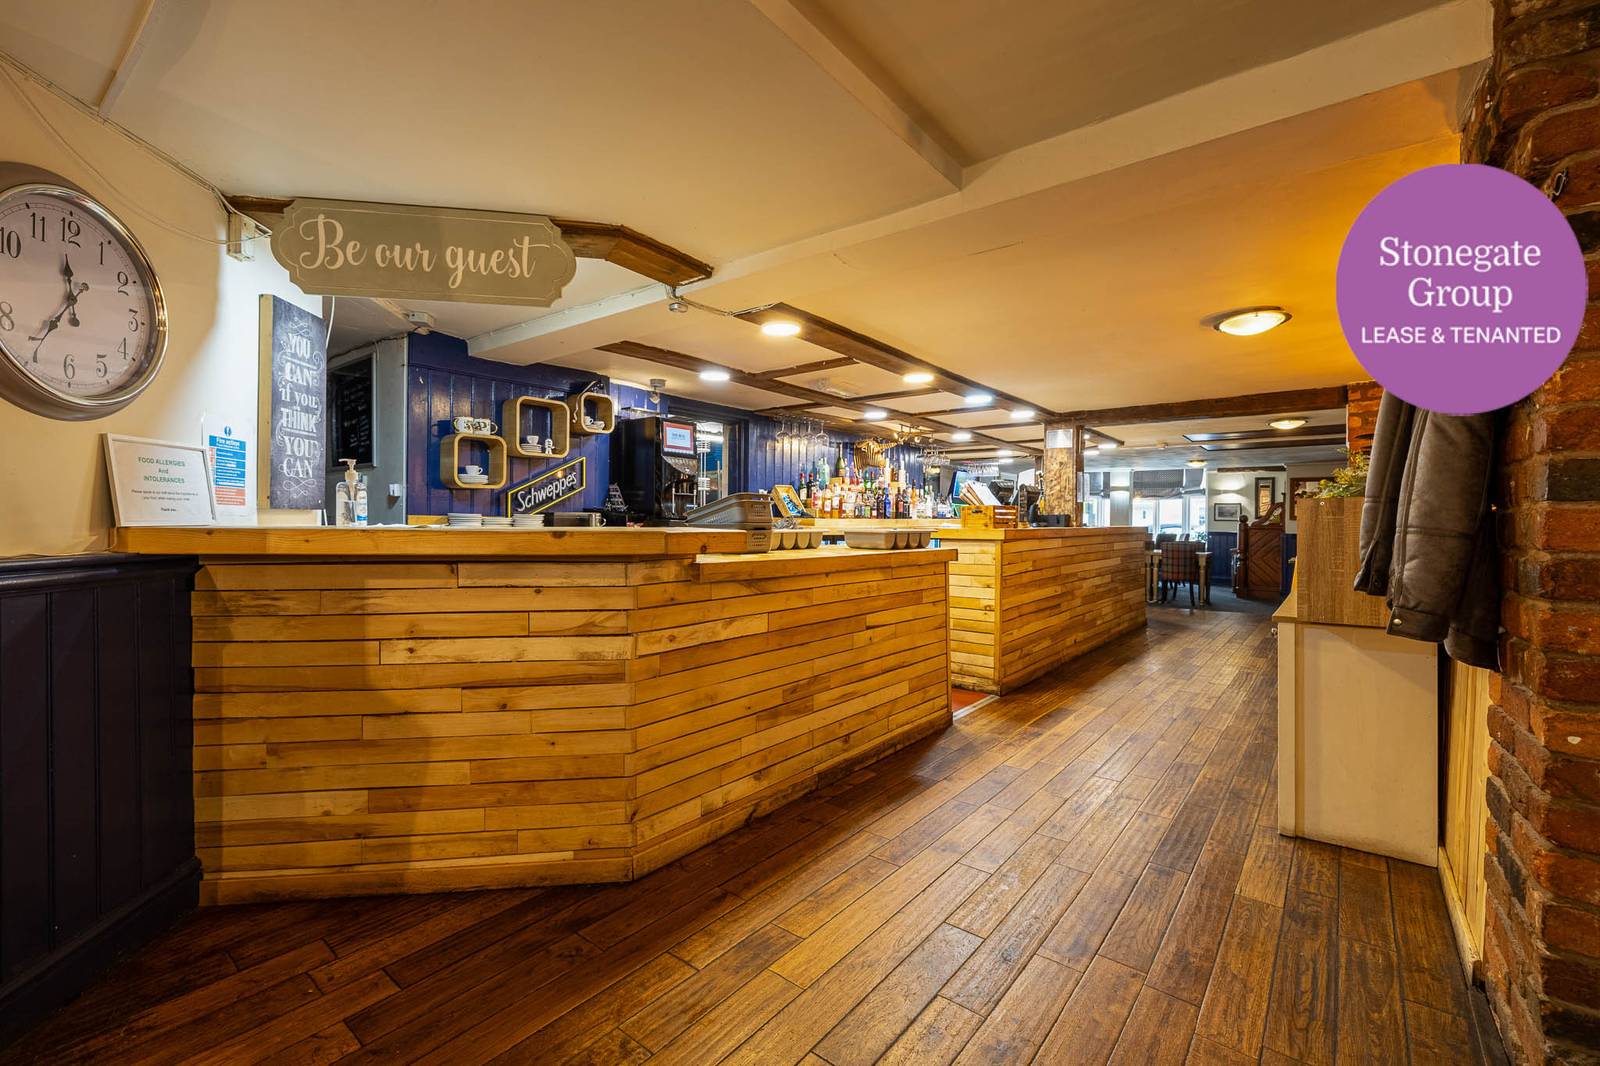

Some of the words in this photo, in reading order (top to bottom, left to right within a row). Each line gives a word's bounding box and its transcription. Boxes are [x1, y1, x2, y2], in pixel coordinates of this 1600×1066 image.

[29, 212, 47, 242] 11
[60, 216, 81, 248] 12
[0, 226, 22, 259] 10
[98, 241, 105, 265] 1
[299, 214, 367, 270] Be
[375, 243, 437, 272] our
[445, 236, 551, 288] guest
[117, 271, 129, 296] 2
[0, 301, 15, 331] 8
[128, 309, 139, 332] 3
[28, 335, 44, 363] 7
[117, 337, 128, 360] 4
[287, 333, 311, 361] YOU
[63, 354, 76, 380] 6
[96, 354, 108, 379] 5
[285, 363, 314, 387] CAN
[279, 386, 292, 402] if
[280, 407, 317, 433] THINK
[284, 435, 315, 457] YOU
[138, 457, 155, 465] FOOD
[155, 459, 185, 467] ALLERGIES
[283, 458, 313, 479] CAN
[143, 475, 185, 484] INTOLERANCES
[517, 471, 577, 511] Schweppes
